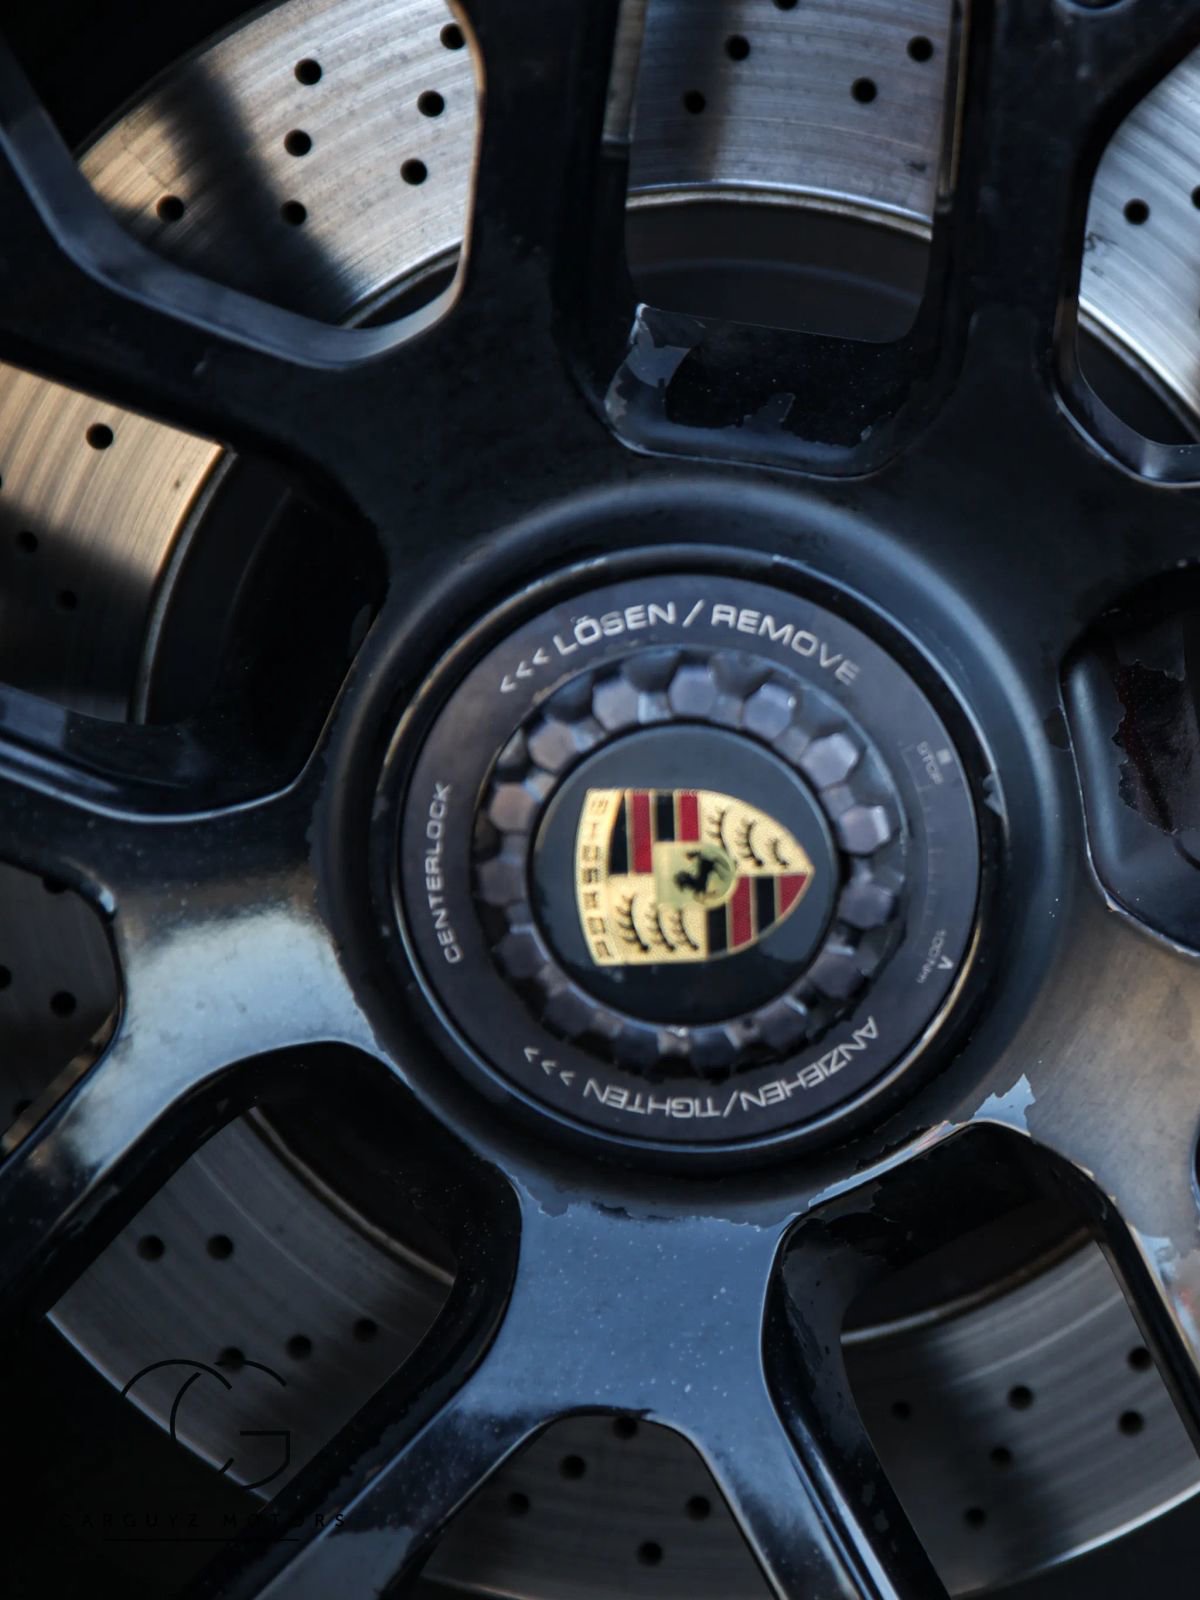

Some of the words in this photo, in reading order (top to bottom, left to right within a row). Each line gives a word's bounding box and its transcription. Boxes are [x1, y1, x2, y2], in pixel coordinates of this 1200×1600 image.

[552, 602, 676, 654] LÖSEN
[710, 604, 862, 685] REMOVE
[426, 781, 463, 965] CENTERLOCK
